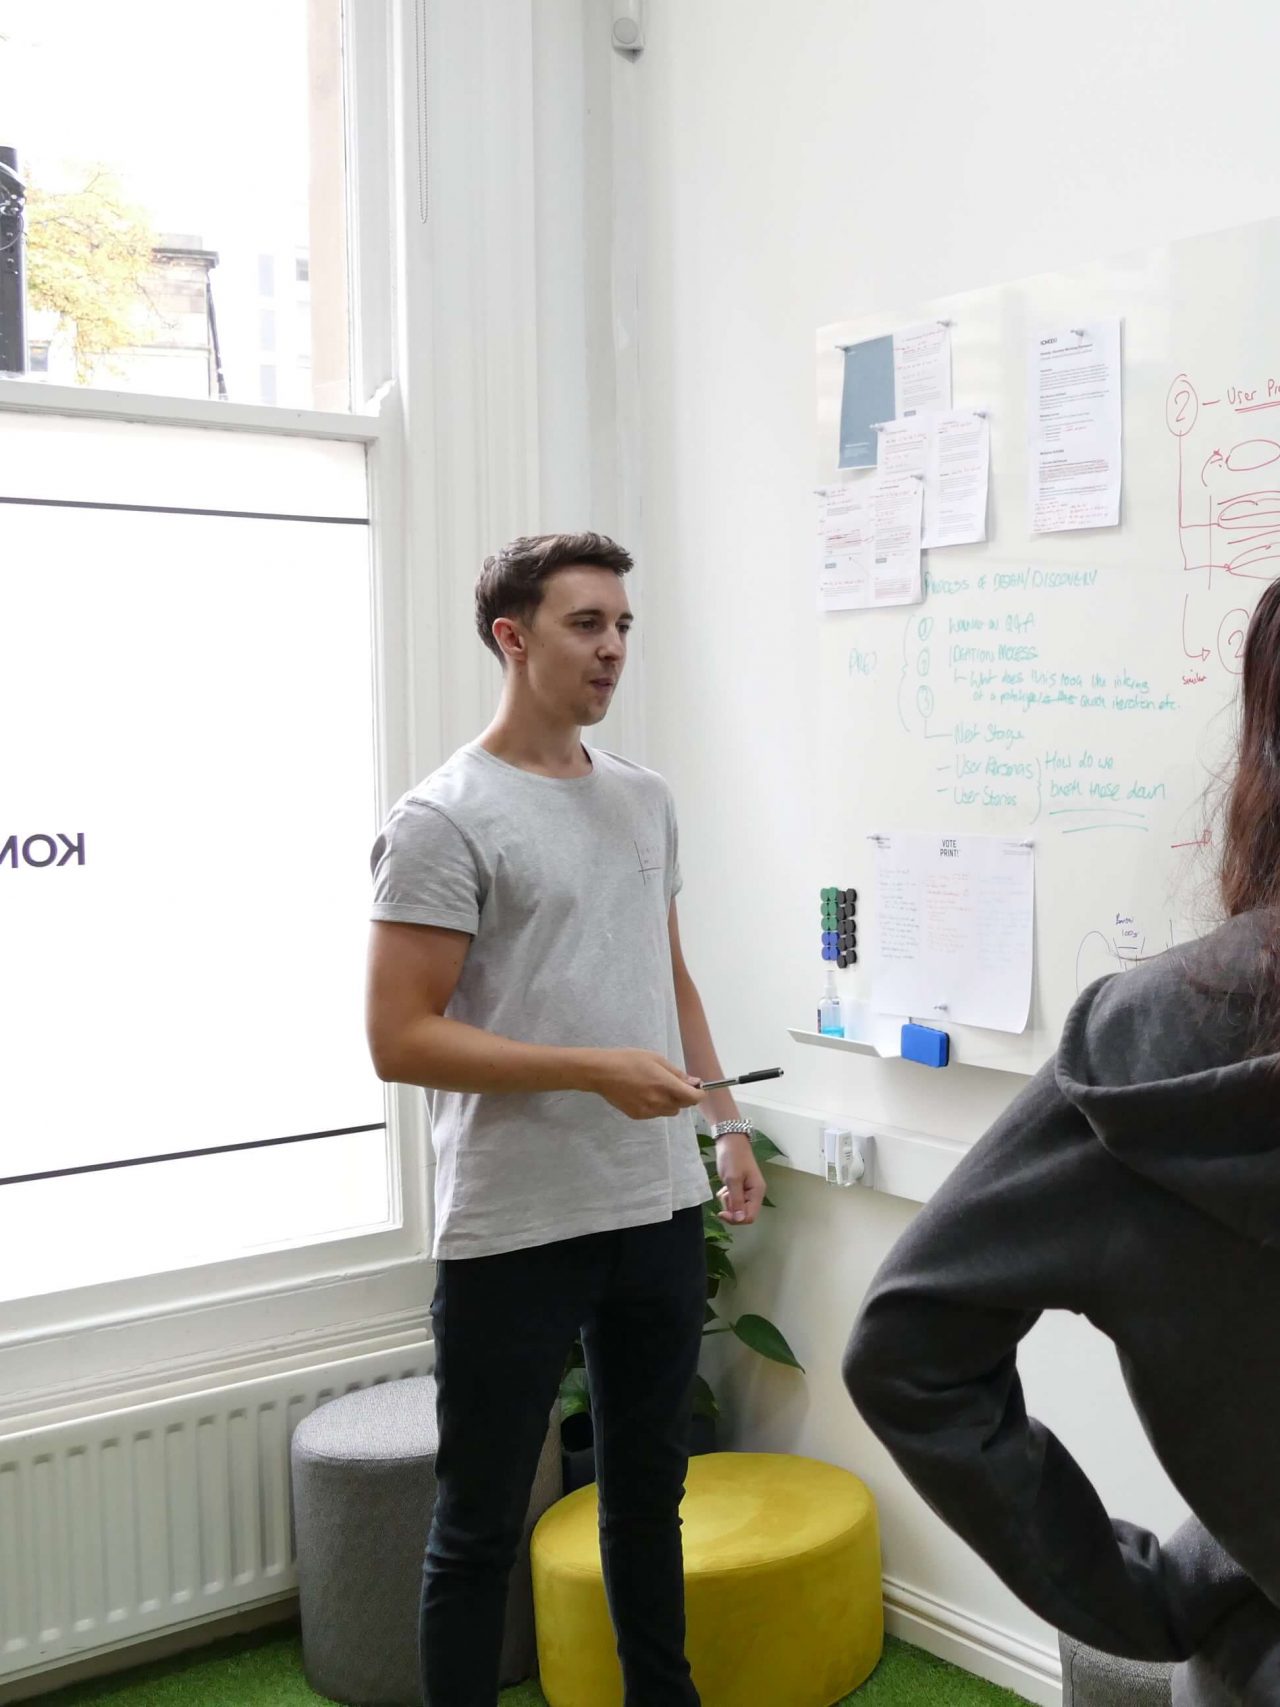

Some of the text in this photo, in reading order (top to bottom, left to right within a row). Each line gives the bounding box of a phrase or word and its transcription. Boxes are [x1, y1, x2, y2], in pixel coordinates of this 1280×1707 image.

[1227, 387, 1257, 405] User
[1175, 391, 1190, 421] 2
[956, 754, 982, 778] User
[1078, 751, 1094, 768] do
[1127, 780, 1167, 800] down
[941, 839, 957, 848] VOTE
